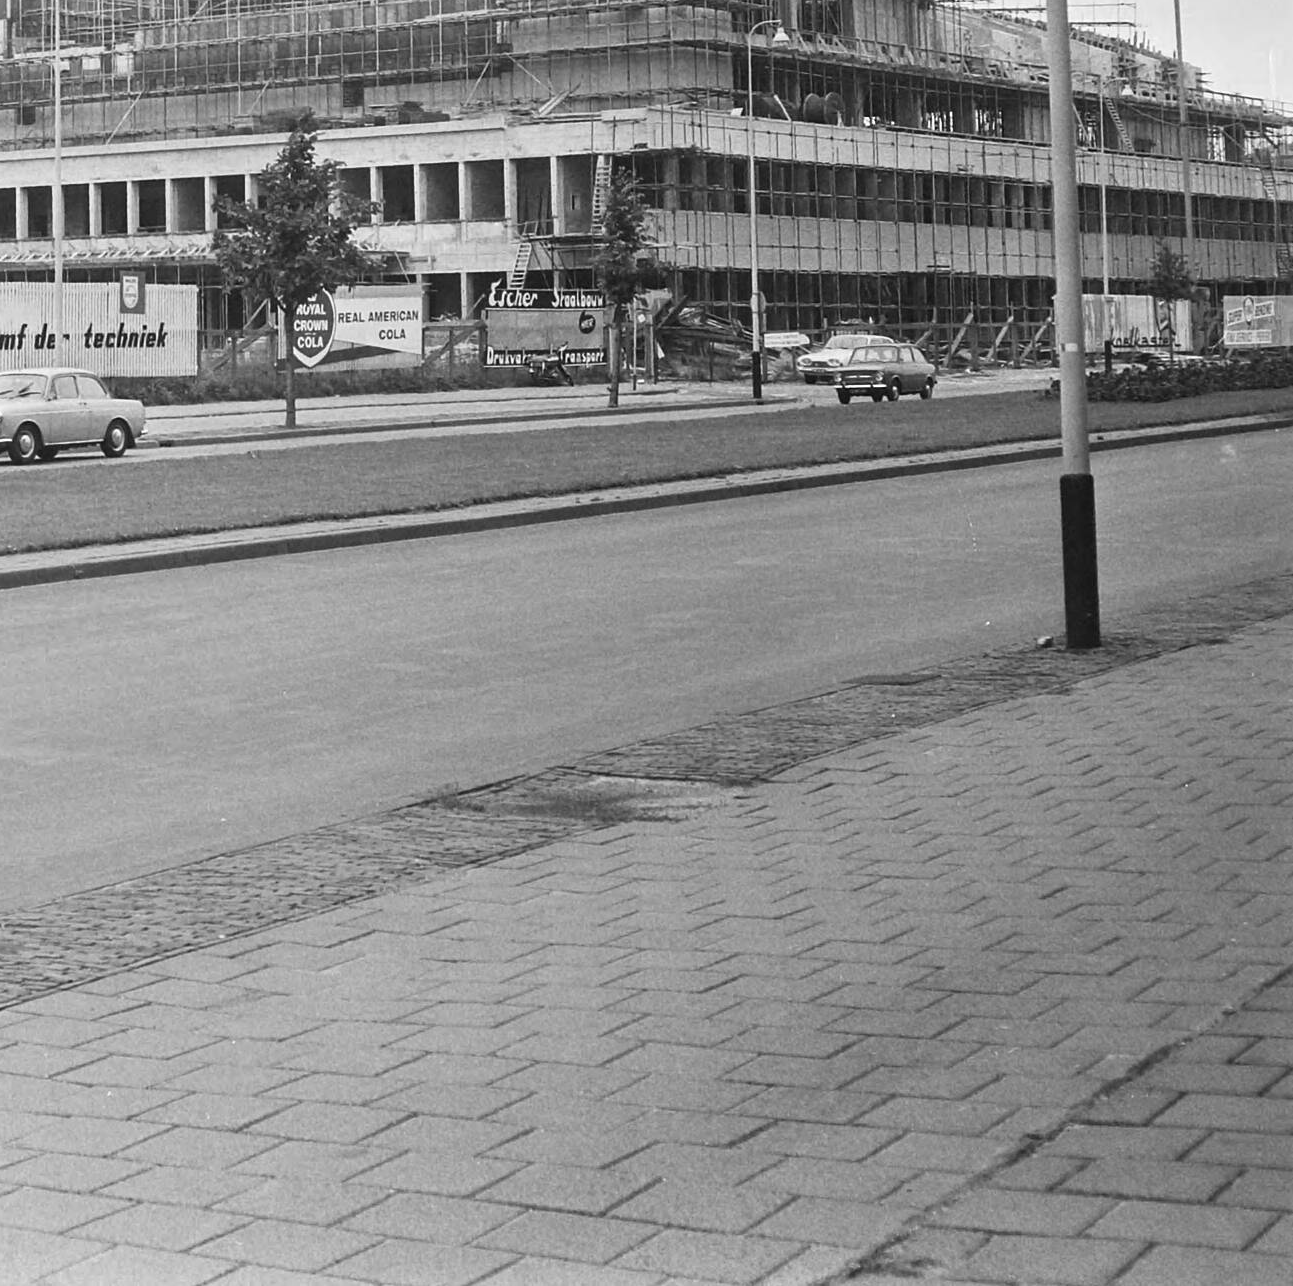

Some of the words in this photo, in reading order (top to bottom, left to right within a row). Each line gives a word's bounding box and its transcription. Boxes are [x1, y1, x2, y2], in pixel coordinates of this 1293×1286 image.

[489, 278, 538, 307] Escher
[551, 286, 603, 307] Staalbouw
[296, 303, 326, 315] ROYAL
[338, 312, 365, 323] REAL
[368, 310, 419, 322] AMERICAN
[294, 319, 328, 331] CROWN
[84, 322, 168, 349] techniek
[378, 329, 406, 340] COLA
[297, 336, 323, 348] COLA
